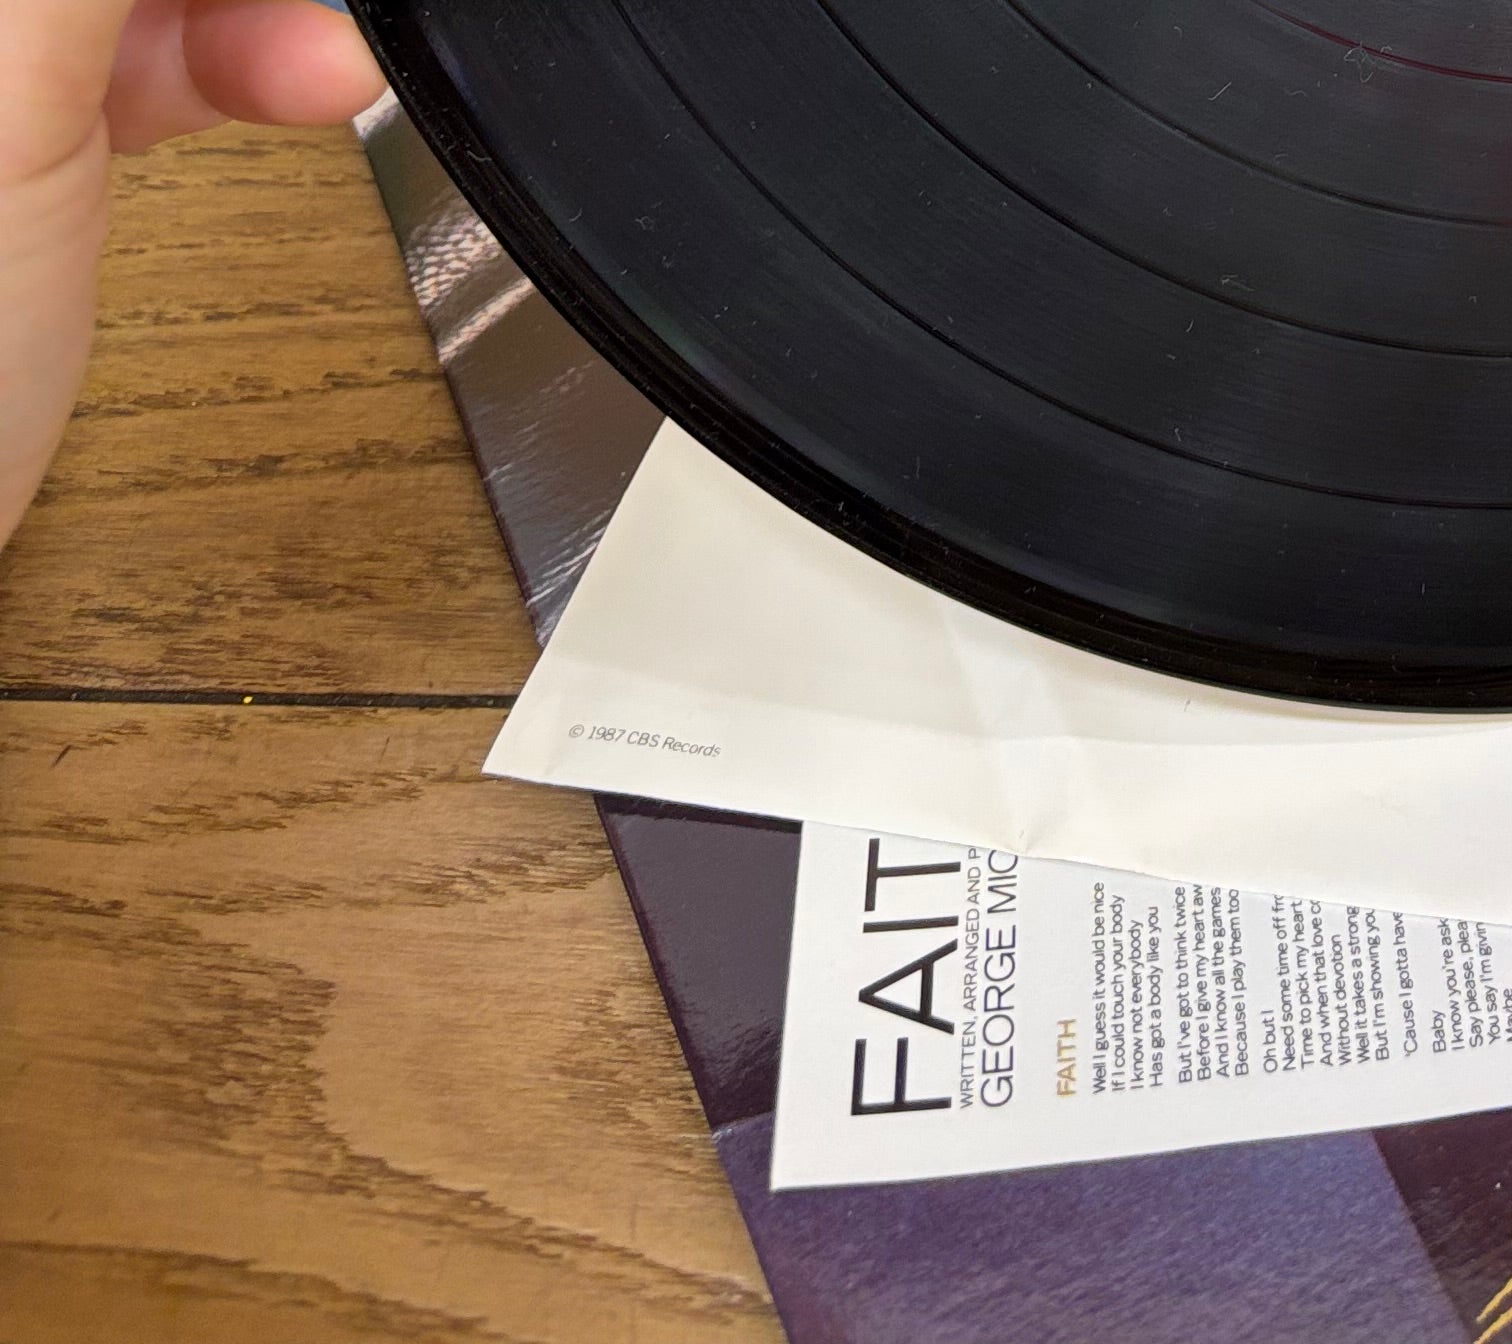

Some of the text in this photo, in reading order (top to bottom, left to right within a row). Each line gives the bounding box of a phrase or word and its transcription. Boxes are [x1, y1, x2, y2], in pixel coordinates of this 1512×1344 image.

[588, 725, 626, 743] 1987
[627, 730, 661, 749] CBS
[662, 736, 722, 758] Records
[960, 866, 981, 1109] WRITTEN, ARRANGED AND
[980, 925, 1016, 1108] GEORGE
[1056, 1019, 1076, 1096] FAITH
[1092, 882, 1109, 1094] Well guess it would be nice
[1109, 895, 1127, 1092] If could touch your body
[1128, 920, 1144, 1082] know not everybody
[1146, 906, 1165, 1087] Has got body like you
[1174, 886, 1193, 1084] But I've got to think twice
[1192, 908, 1212, 1081] Before give my heart
[1210, 887, 1230, 1078] And know all the games
[1227, 889, 1249, 1076] Because play them too
[1262, 1017, 1278, 1074] Oh but
[1272, 916, 1296, 1071] Need some time off
[1290, 900, 1315, 1070] Time to pick my heart
[1311, 917, 1334, 1066] And when that love
[1331, 934, 1352, 1066] Without devotion
[1346, 906, 1370, 1064] Well it takes strong
[1367, 935, 1390, 1061] But I'm showing
[1392, 912, 1418, 1057] 'Cause gotta have
[1431, 1010, 1447, 1053] Baby
[1442, 949, 1464, 1044] know you're
[1462, 957, 1484, 1048] Say please,
[1479, 959, 1501, 1045] You say I'm
